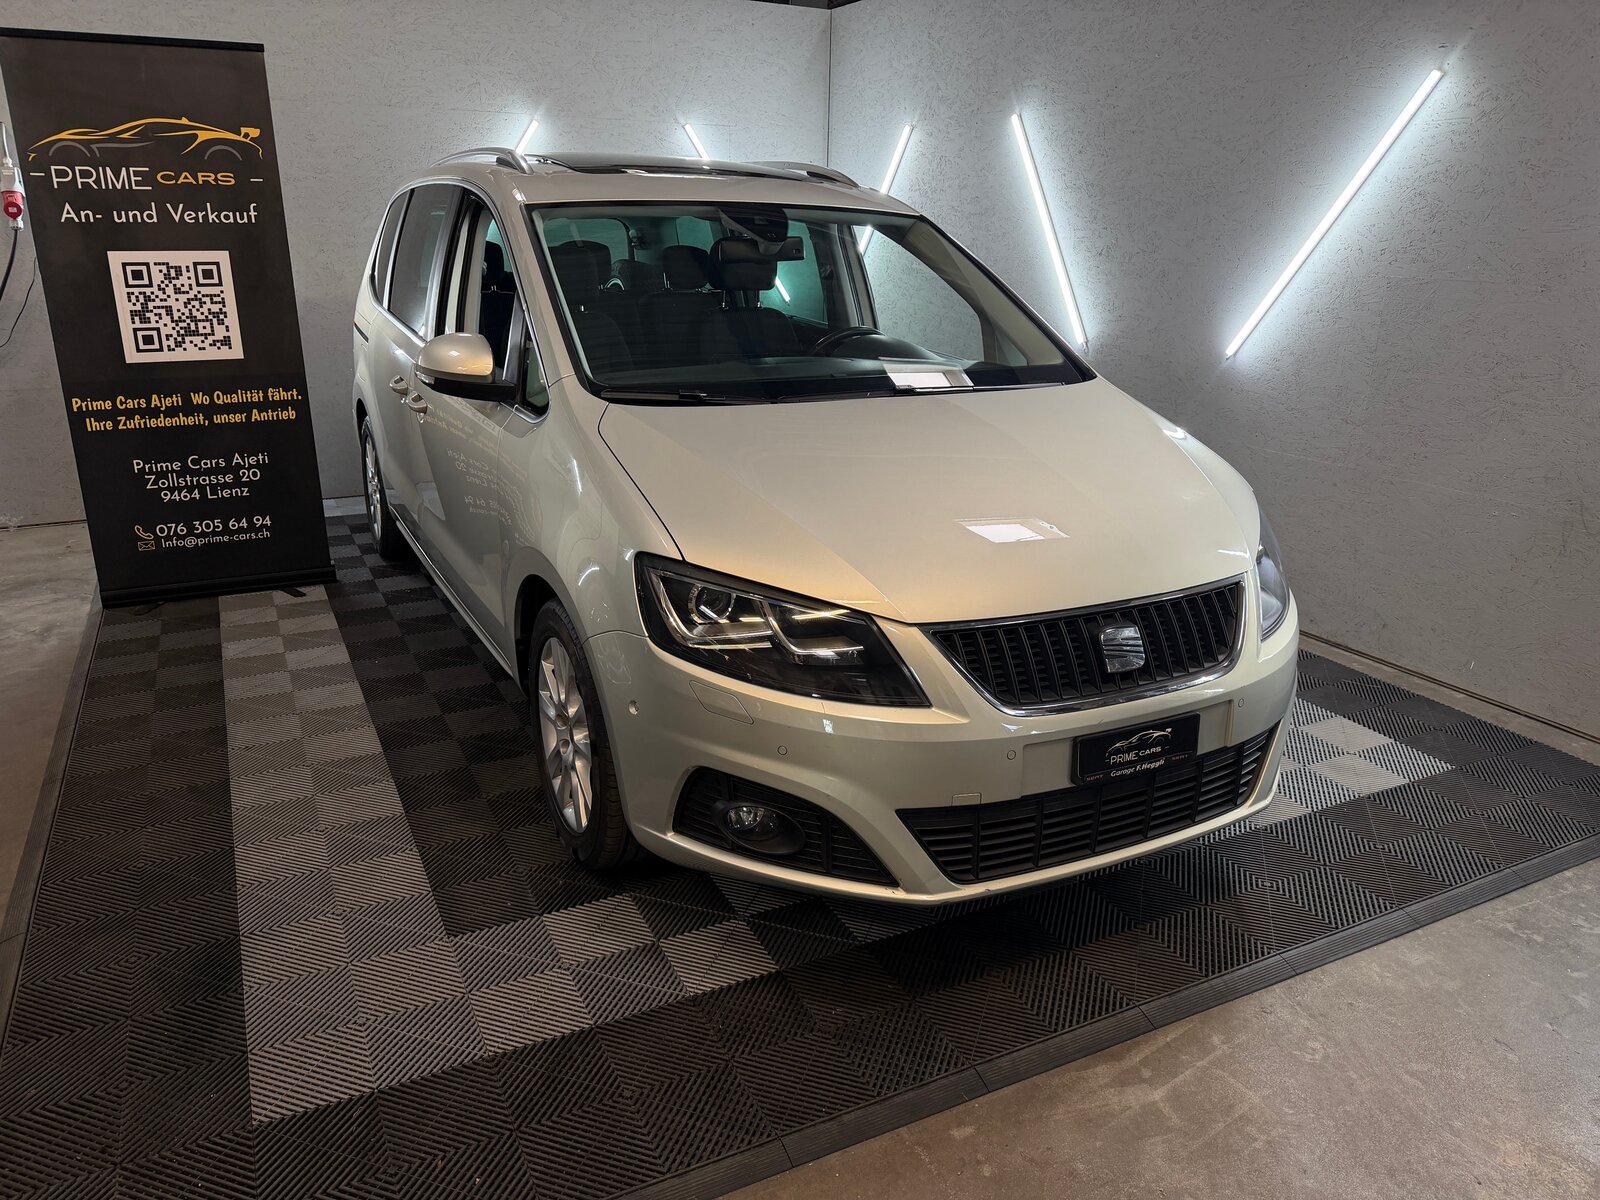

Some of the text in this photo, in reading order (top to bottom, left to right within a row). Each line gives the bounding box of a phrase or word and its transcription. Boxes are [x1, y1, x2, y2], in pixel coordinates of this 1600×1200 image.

[50, 165, 236, 190] PRIME CARS
[60, 202, 258, 224] An- und Verkauf
[71, 387, 302, 412] Prime Cars Ajeti Wo Qualität fährt.
[85, 406, 297, 432] Ihre Zufriedenheit, unser Antrieb
[133, 452, 269, 473] Prime Cars Ajeti
[144, 468, 261, 490] Zollstrasse 20
[160, 485, 250, 503] 9464 Lienz
[155, 515, 272, 537] 076 305 64 94
[161, 528, 271, 548] Info@prime-cars.ch
[1110, 746, 1162, 765] PRIME CARS
[1110, 766, 1136, 777] Garage
